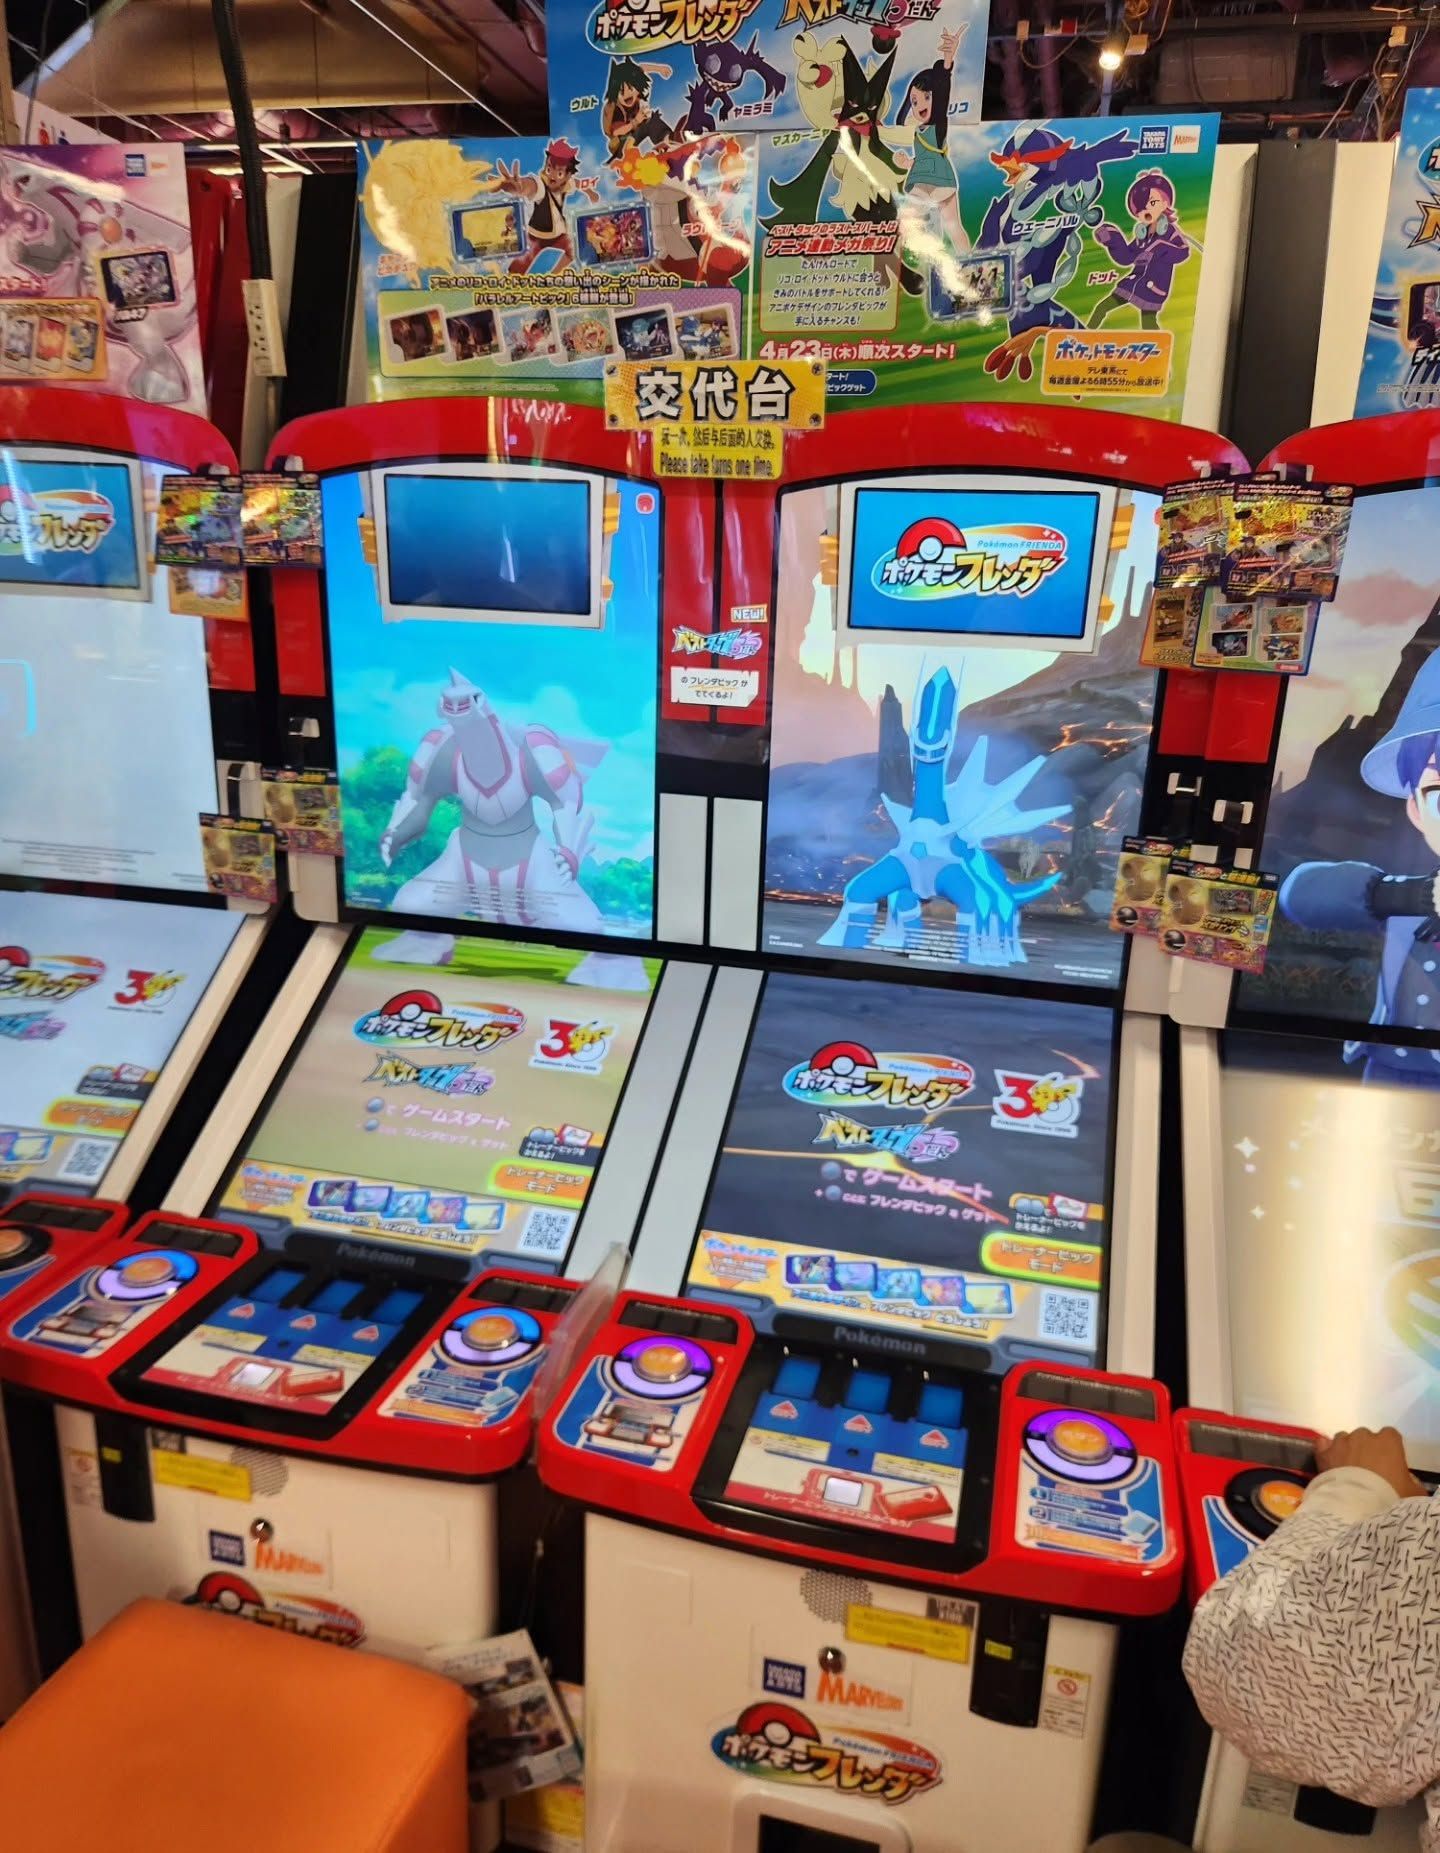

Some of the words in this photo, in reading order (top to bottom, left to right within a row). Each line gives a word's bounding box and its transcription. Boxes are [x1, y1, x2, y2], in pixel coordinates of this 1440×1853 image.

[570, 95, 599, 111] ウルト
[733, 102, 774, 118] ヤミラミ
[801, 259, 858, 269] たんけんロードで
[1086, 271, 1120, 285] ドット
[1055, 338, 1161, 361] ポケットモンスター
[635, 364, 795, 421] 交代台
[977, 540, 1018, 549] Pokémon
[1020, 541, 1063, 550] FRIENDA
[881, 551, 1065, 593] ポケモンフレンダ
[733, 608, 765, 620] NEW!
[362, 1014, 515, 1051] ポケモンフレンダ
[793, 1068, 965, 1110] ポケモンフレンダ
[403, 1103, 511, 1131] ゲームスタート
[863, 1168, 993, 1201] ゲームスタート
[869, 1193, 947, 1217] フレンダピック
[834, 1325, 928, 1356] Pokémon
[721, 1730, 933, 1800] ポケモンフレンダ
